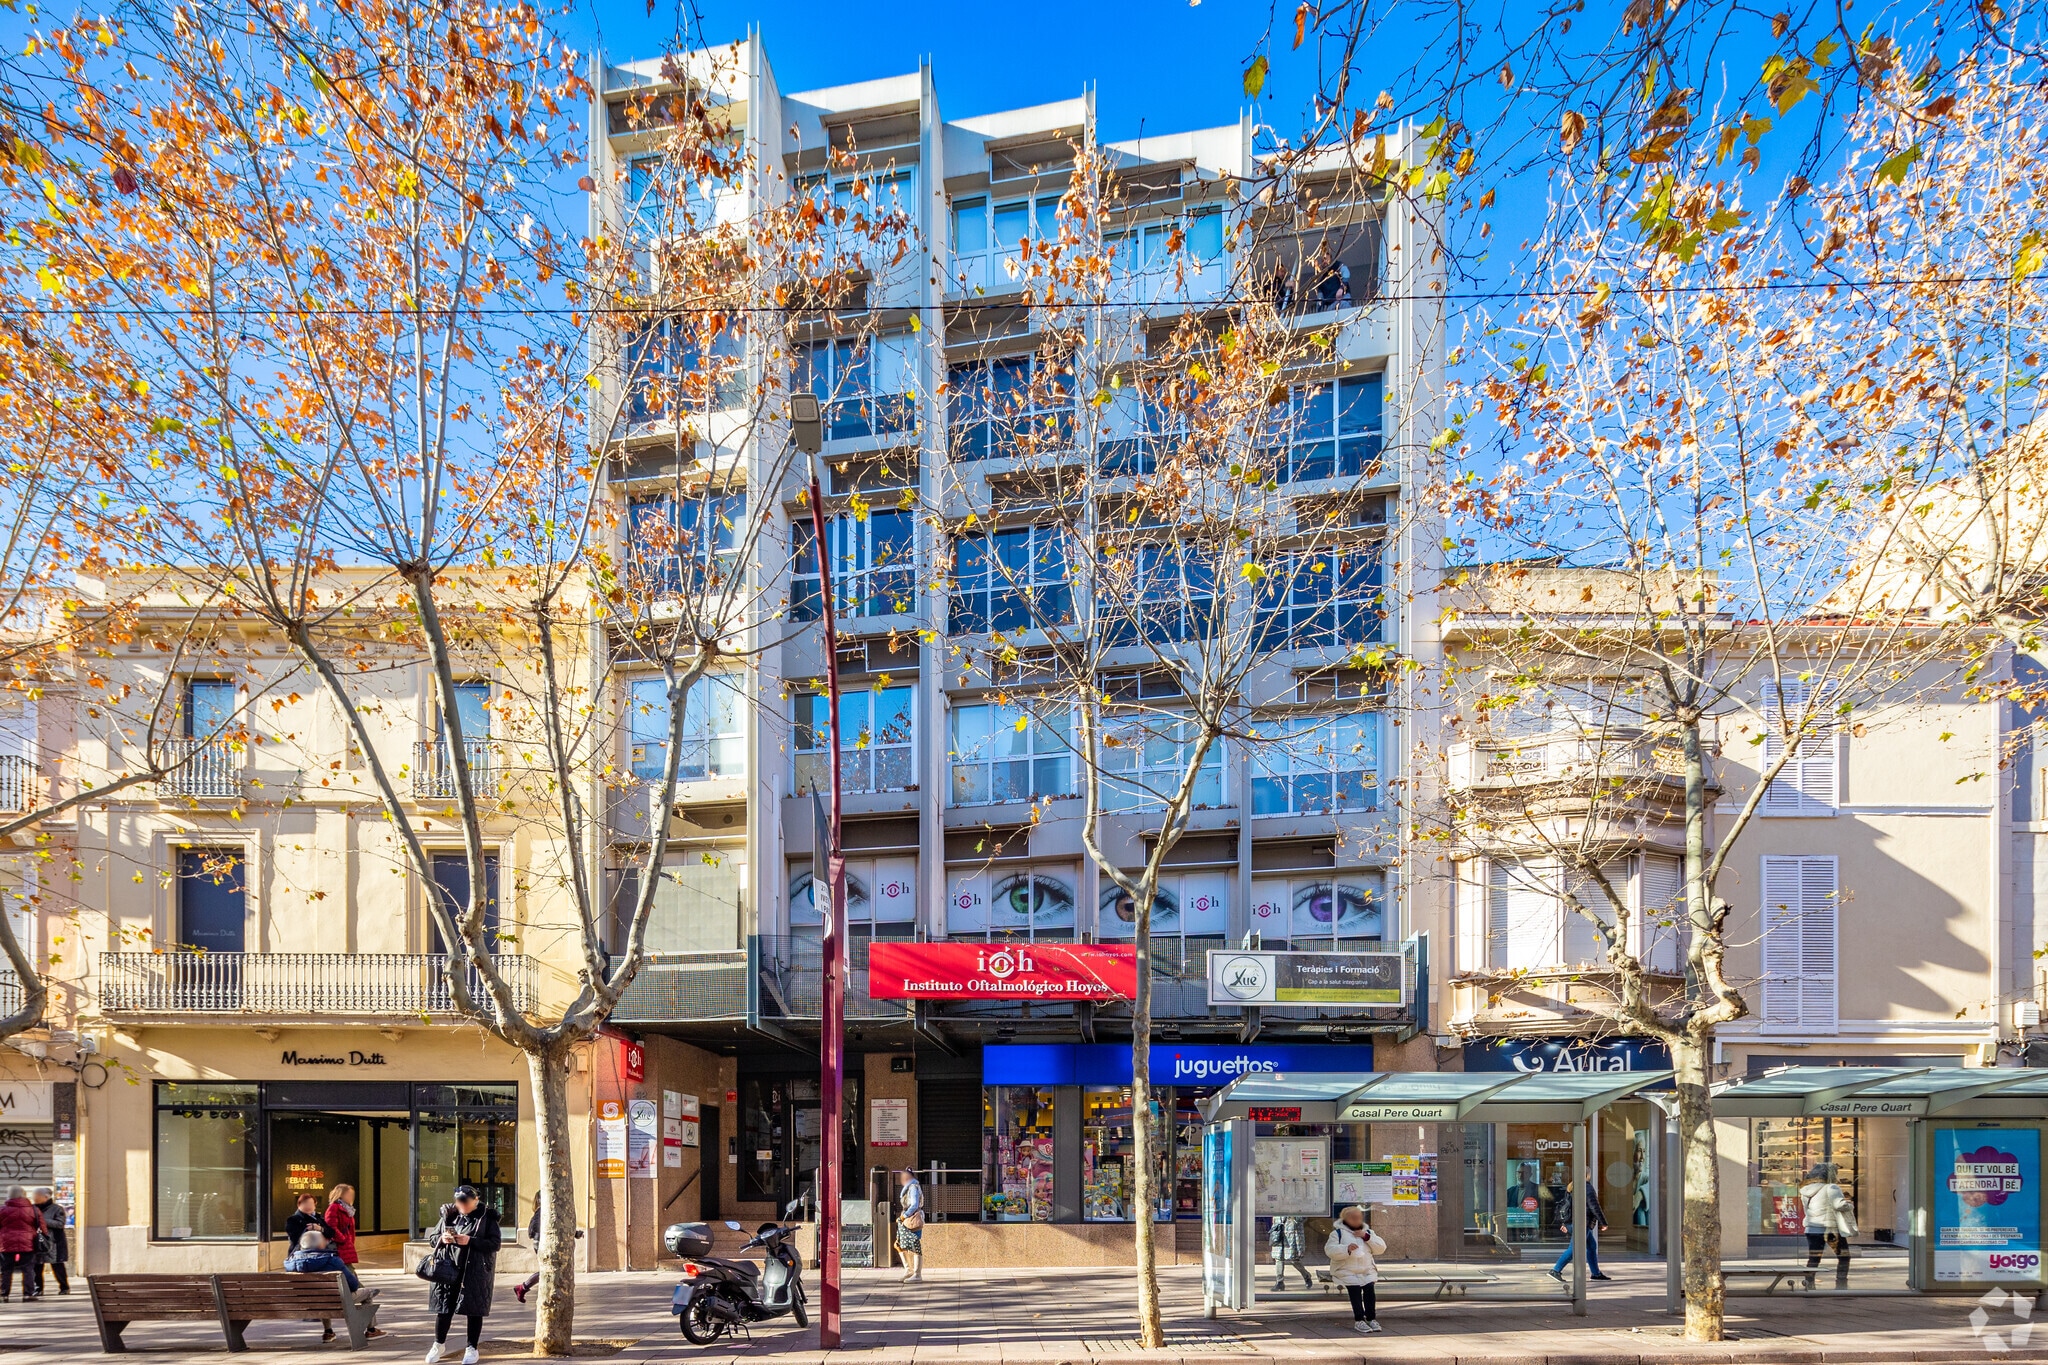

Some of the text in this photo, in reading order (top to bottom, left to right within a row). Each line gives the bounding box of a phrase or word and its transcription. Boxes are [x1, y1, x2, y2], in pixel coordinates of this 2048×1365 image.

[1296, 965, 1333, 974] Teràpies
[1340, 966, 1380, 974] Formació
[903, 979, 1108, 995] Instituto Oftalmológico Hoyos
[281, 1050, 387, 1066] Massimo Dutti
[1552, 1048, 1631, 1072] Aural
[1351, 1108, 1443, 1118] Casal Pere Quart
[1820, 1102, 1912, 1113] Casal Pere Quart
[1956, 1163, 2016, 1174] QUI ET VOL BÉ
[2005, 1180, 2019, 1190] BÉ.
[1990, 1254, 2039, 1269] yoigo
